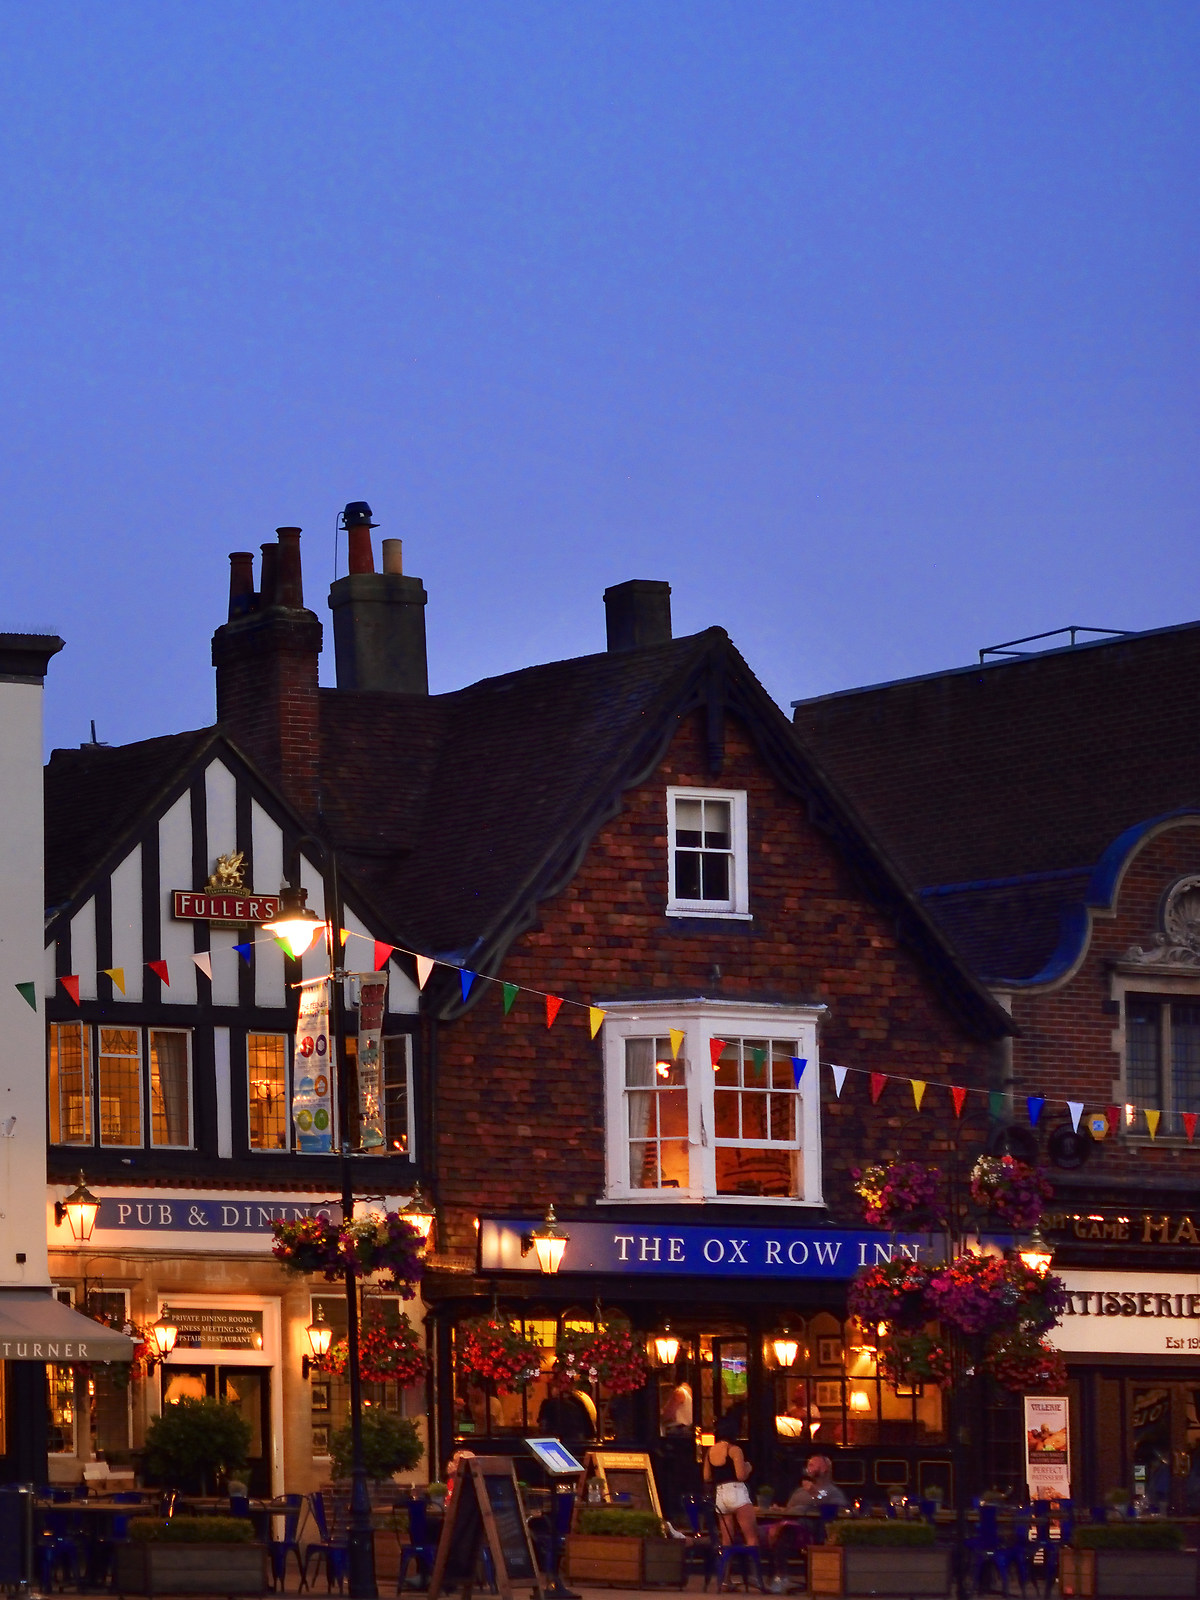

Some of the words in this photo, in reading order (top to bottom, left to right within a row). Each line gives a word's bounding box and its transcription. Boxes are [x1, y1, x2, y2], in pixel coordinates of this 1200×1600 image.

[181, 895, 274, 919] FULLER'S
[117, 1204, 173, 1225] PUB
[188, 1205, 209, 1226] &
[1073, 1216, 1130, 1240] GAME
[614, 1235, 685, 1262] THE
[703, 1239, 749, 1263] OX
[765, 1241, 842, 1266] ROW
[858, 1243, 920, 1266] INN
[2, 1343, 88, 1357] TURNER
[1165, 1336, 1185, 1349] Est
[1187, 1338, 1200, 1349] 19
